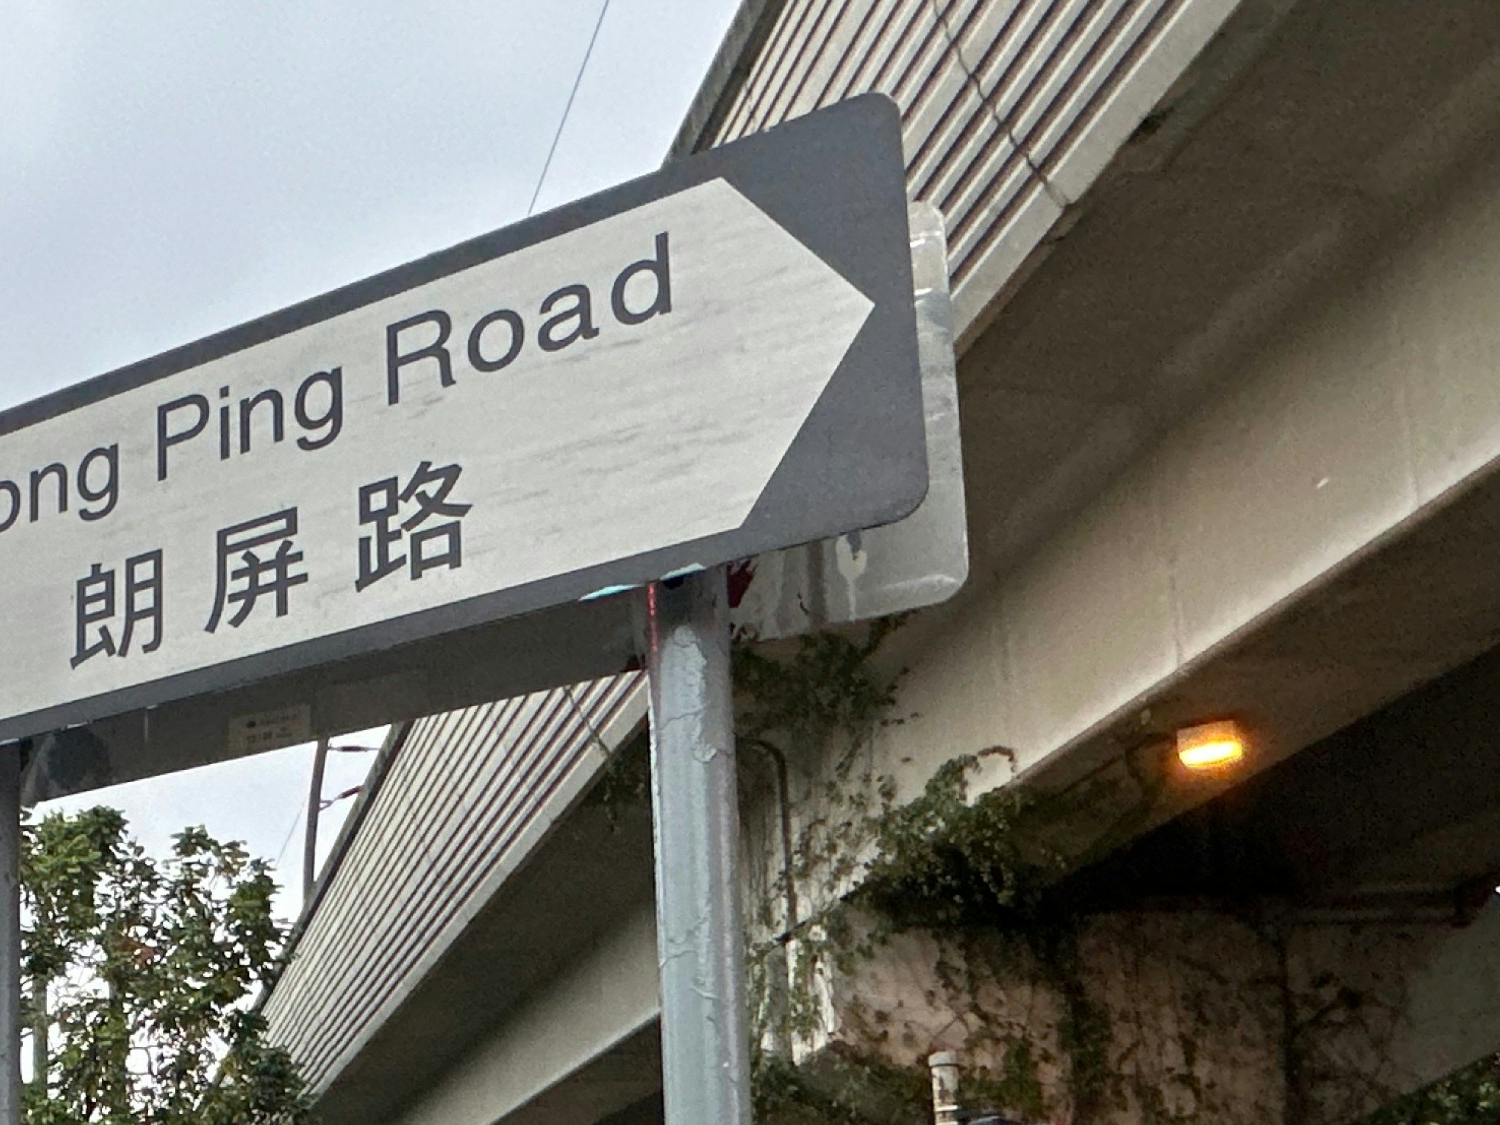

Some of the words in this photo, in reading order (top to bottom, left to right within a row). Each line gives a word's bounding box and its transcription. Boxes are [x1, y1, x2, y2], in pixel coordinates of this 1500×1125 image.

[156, 366, 344, 482] Ping
[386, 231, 672, 406] Road
[70, 461, 473, 670] 朗屏路
